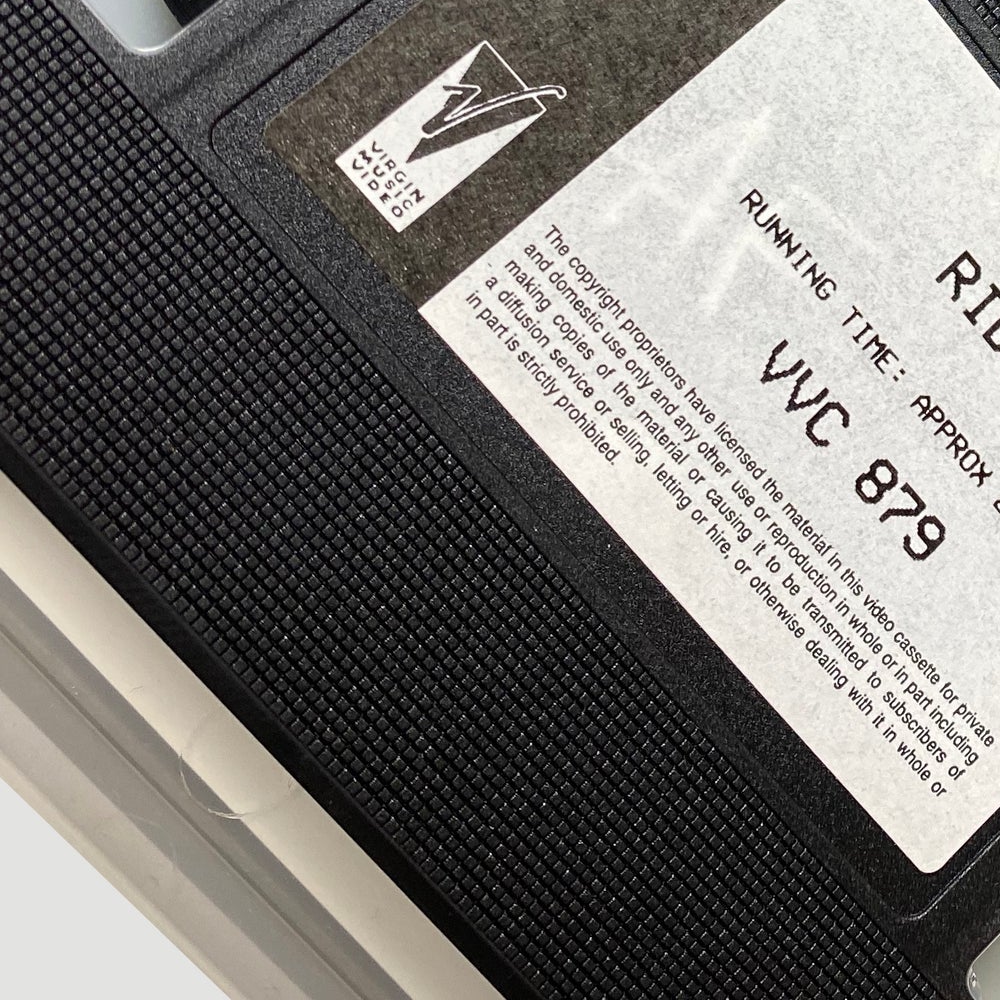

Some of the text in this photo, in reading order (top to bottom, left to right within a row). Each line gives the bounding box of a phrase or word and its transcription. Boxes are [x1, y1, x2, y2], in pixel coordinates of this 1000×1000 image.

[351, 157, 404, 219] VIDEO
[357, 149, 414, 211] MUSIC
[370, 140, 426, 204] VIRGIN
[464, 289, 622, 467] in part is strictly prohibited.
[738, 187, 838, 302] RUNNING
[840, 303, 907, 383] TIME:
[908, 393, 995, 489] APPROX
[758, 337, 947, 563] VVC 879
[484, 275, 948, 798] a diffusion service or selling, letting or hire, or otherwise dealing with it in whole or
[503, 258, 967, 782] making copies of the material or causing it to be transmitted to subscribers of
[523, 243, 980, 768] and domestic use only and any other use or reproduction in whole or in part including
[544, 223, 996, 749] The copyright proprietors have licensed the material in this video cassette for private
